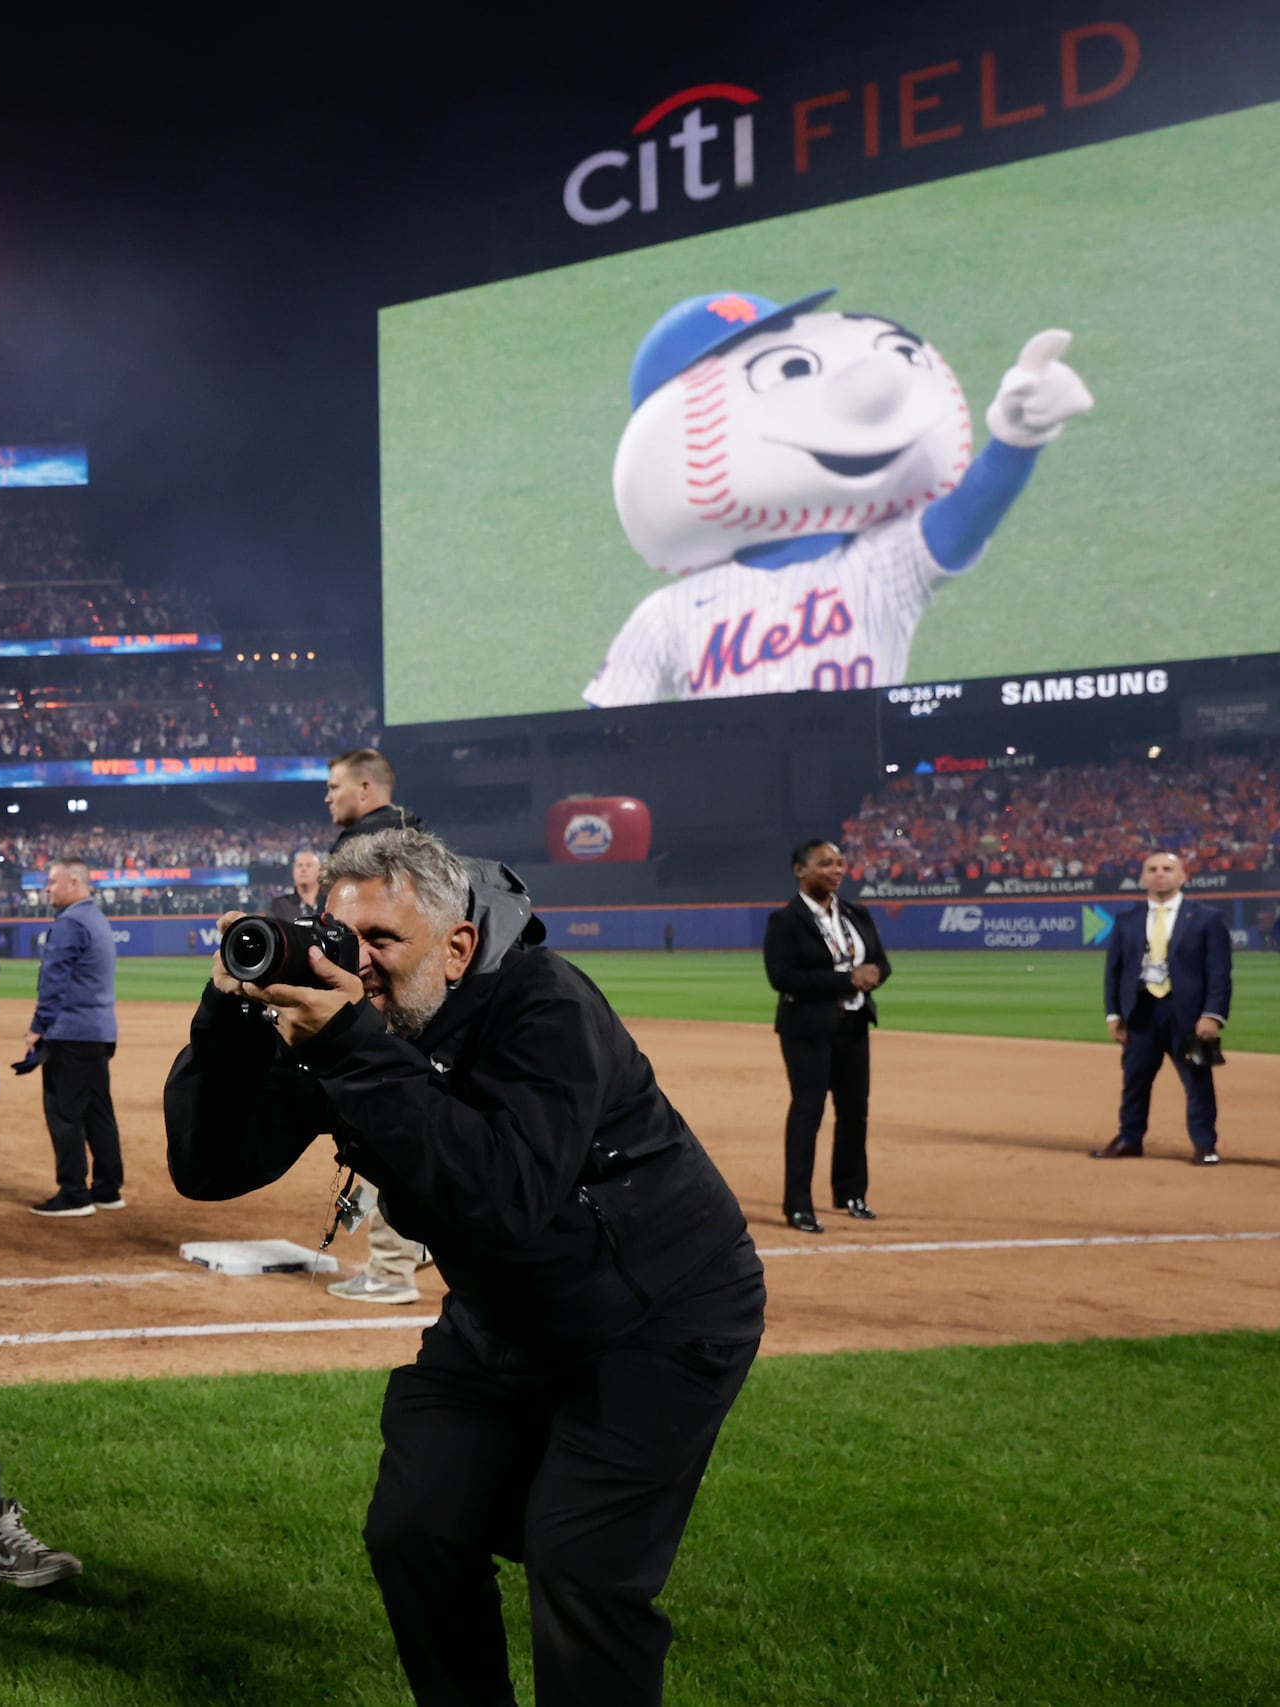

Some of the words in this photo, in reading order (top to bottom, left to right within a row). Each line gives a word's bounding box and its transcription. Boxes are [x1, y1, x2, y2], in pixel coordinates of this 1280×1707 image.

[563, 106, 755, 226] citi
[793, 22, 1142, 174] FIELD
[688, 585, 853, 694] Mets
[935, 684, 962, 699] PM
[1001, 669, 1169, 706] SAMSUNG
[987, 753, 1036, 769] LIGHT
[984, 916, 1077, 931] HAUGLAND
[984, 933, 1042, 947] GROUP
